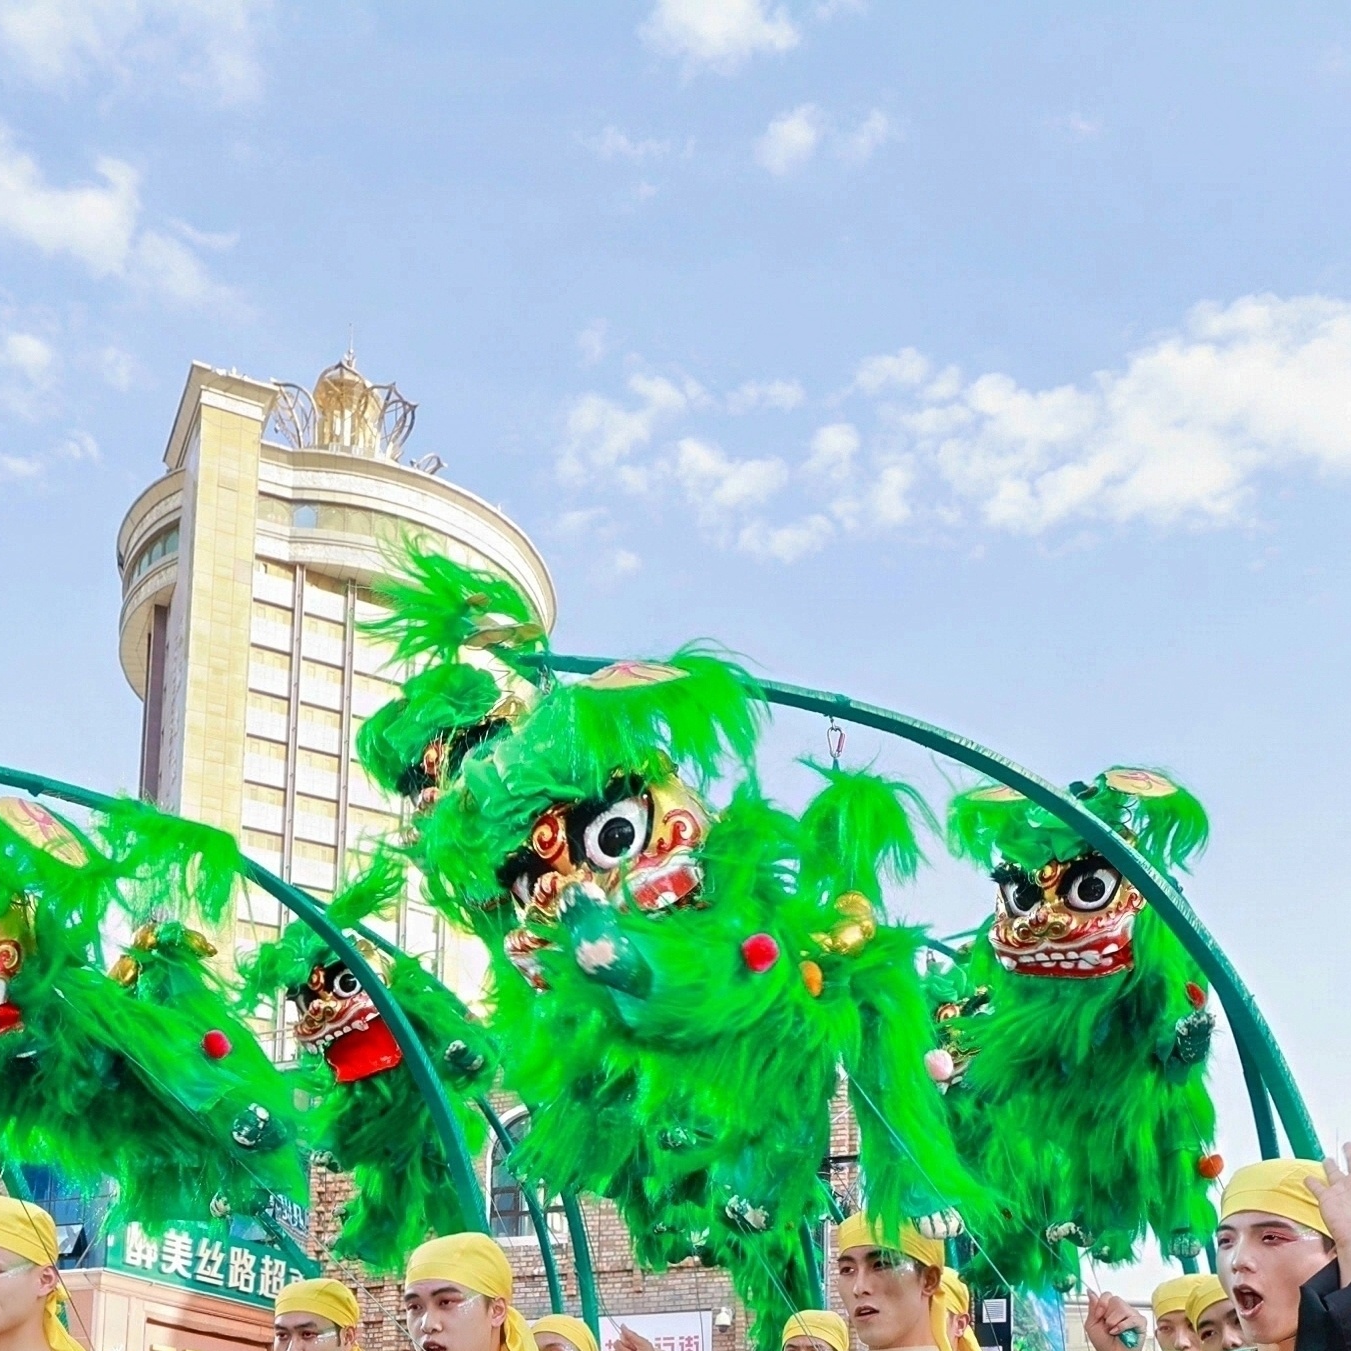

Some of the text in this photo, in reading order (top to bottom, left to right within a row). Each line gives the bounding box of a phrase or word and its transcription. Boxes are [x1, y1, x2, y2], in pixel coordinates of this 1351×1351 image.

[124, 1221, 306, 1300] 醉美丝路超
